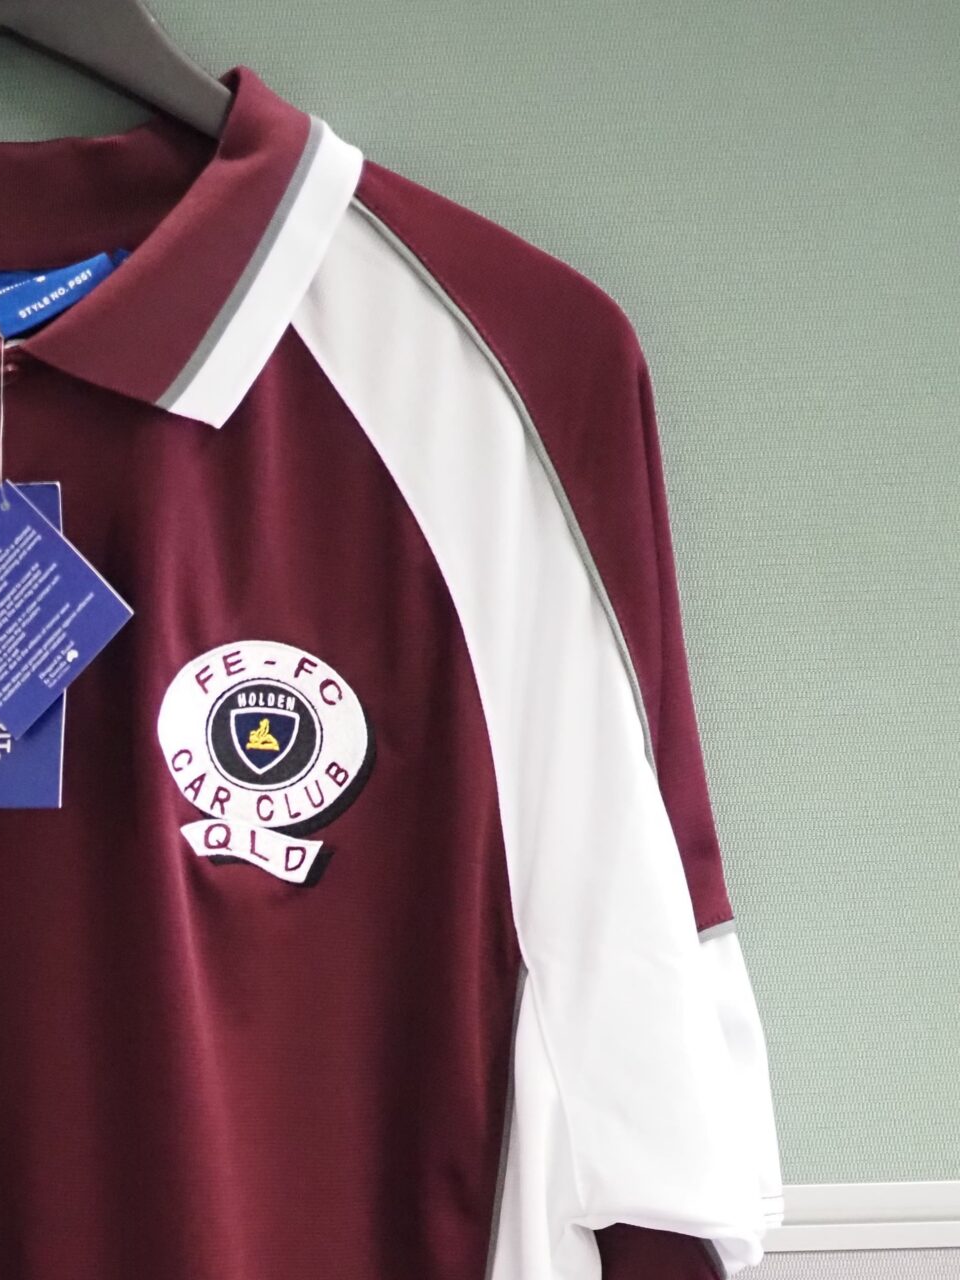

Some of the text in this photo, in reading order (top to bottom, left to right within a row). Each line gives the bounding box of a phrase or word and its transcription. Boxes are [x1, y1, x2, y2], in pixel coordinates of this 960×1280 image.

[18, 295, 50, 319] STYLE
[50, 287, 69, 301] NO.
[237, 692, 296, 711] HOLDEN
[171, 749, 349, 821] CAR CLUB
[204, 823, 307, 871] QLD
